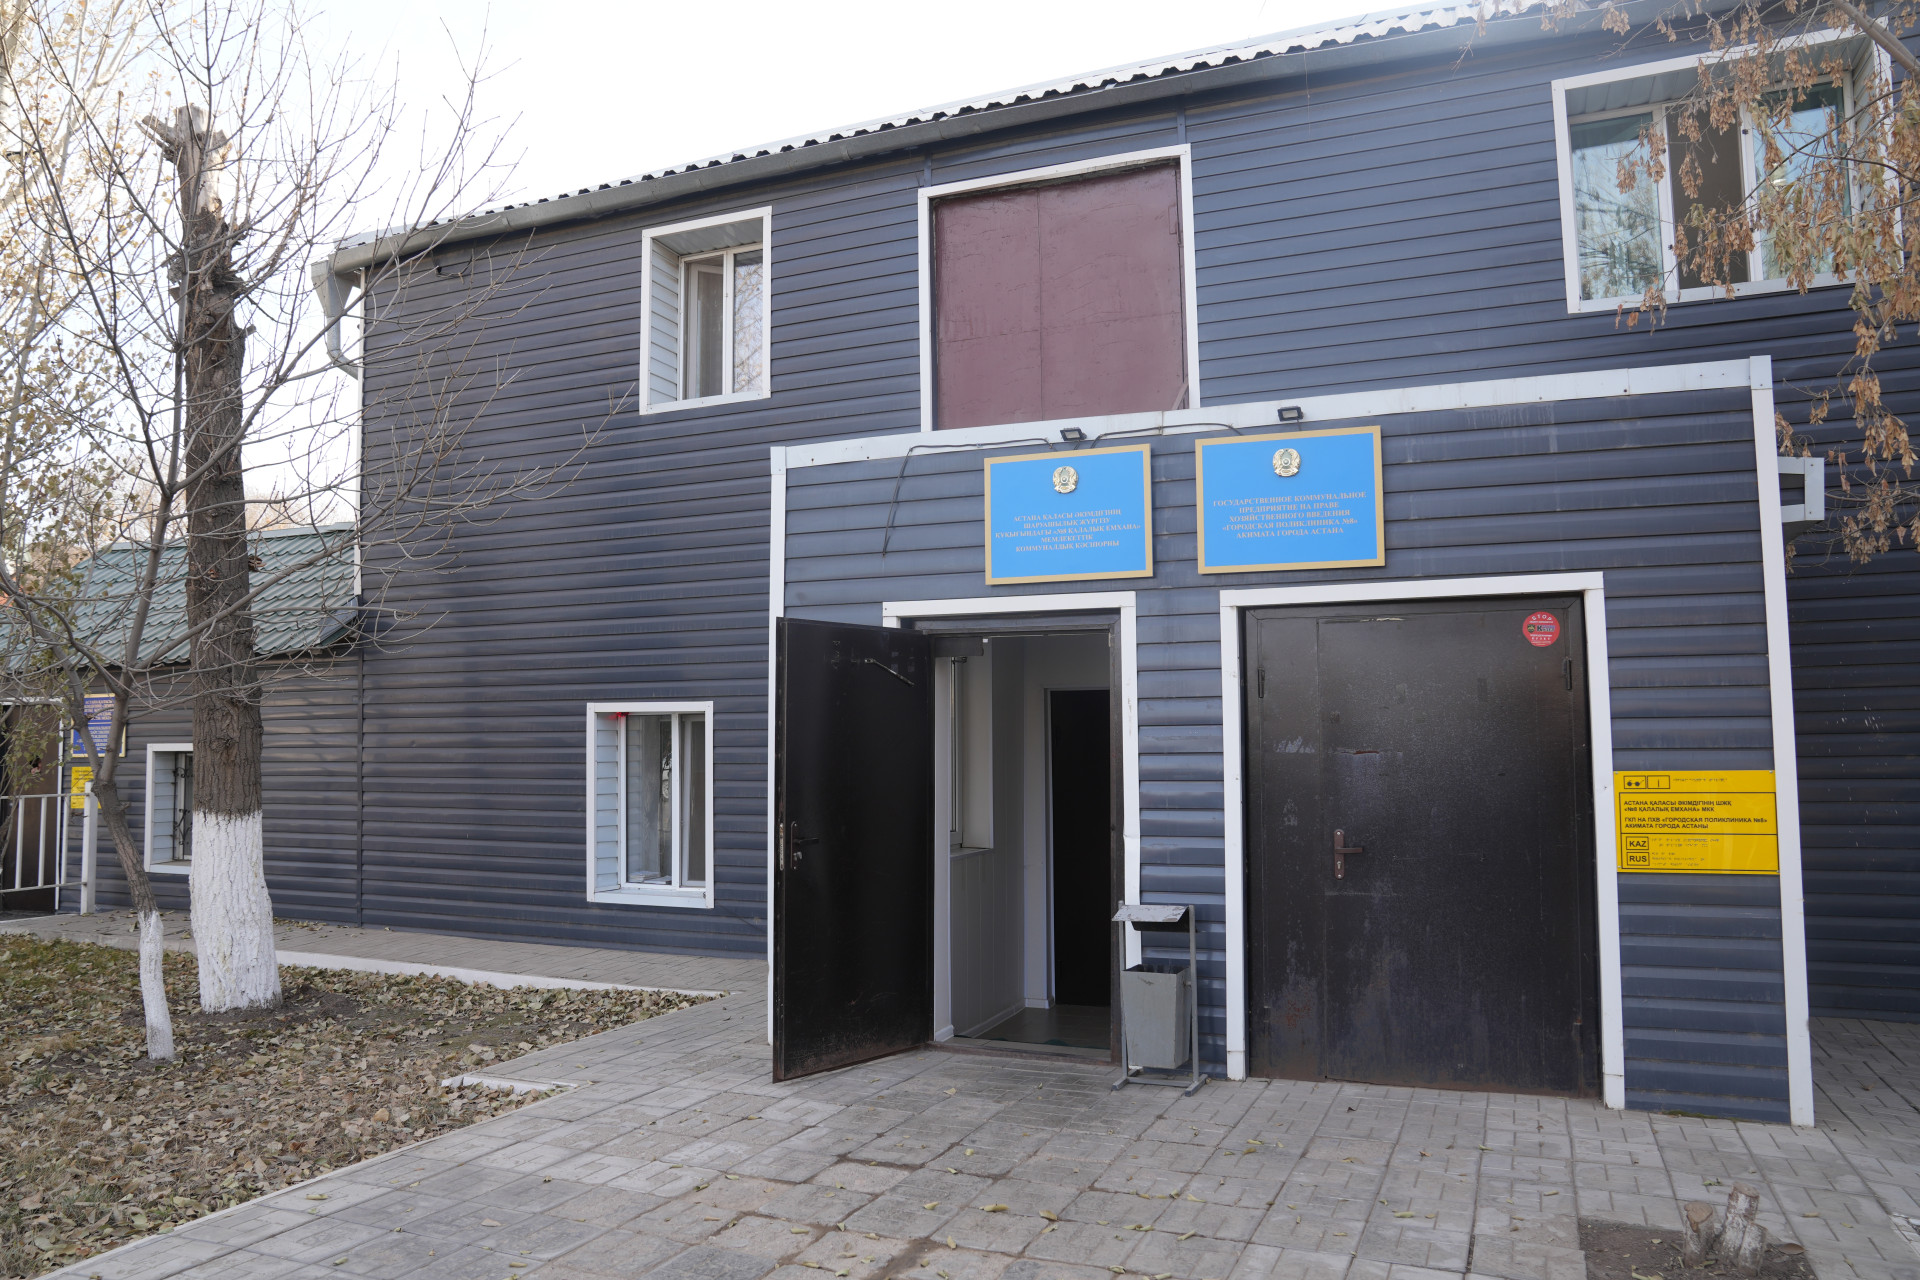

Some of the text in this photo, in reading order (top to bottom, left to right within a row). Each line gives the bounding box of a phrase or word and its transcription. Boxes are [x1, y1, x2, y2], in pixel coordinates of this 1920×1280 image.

[1214, 492, 1366, 506] ГОСУДАРСТВЕННОЕ КОММУНАЛЬНОЕ
[1239, 504, 1297, 513] ПРЕДПРИЯТИЕ
[1229, 512, 1304, 522] ХОЗЯЙСТВЕННОГО
[1222, 523, 1274, 531] «ГОРОДСКАЯ
[1276, 519, 1340, 528] ПОЛИКЛИНИКА
[1236, 531, 1275, 539] АКИМАТА
